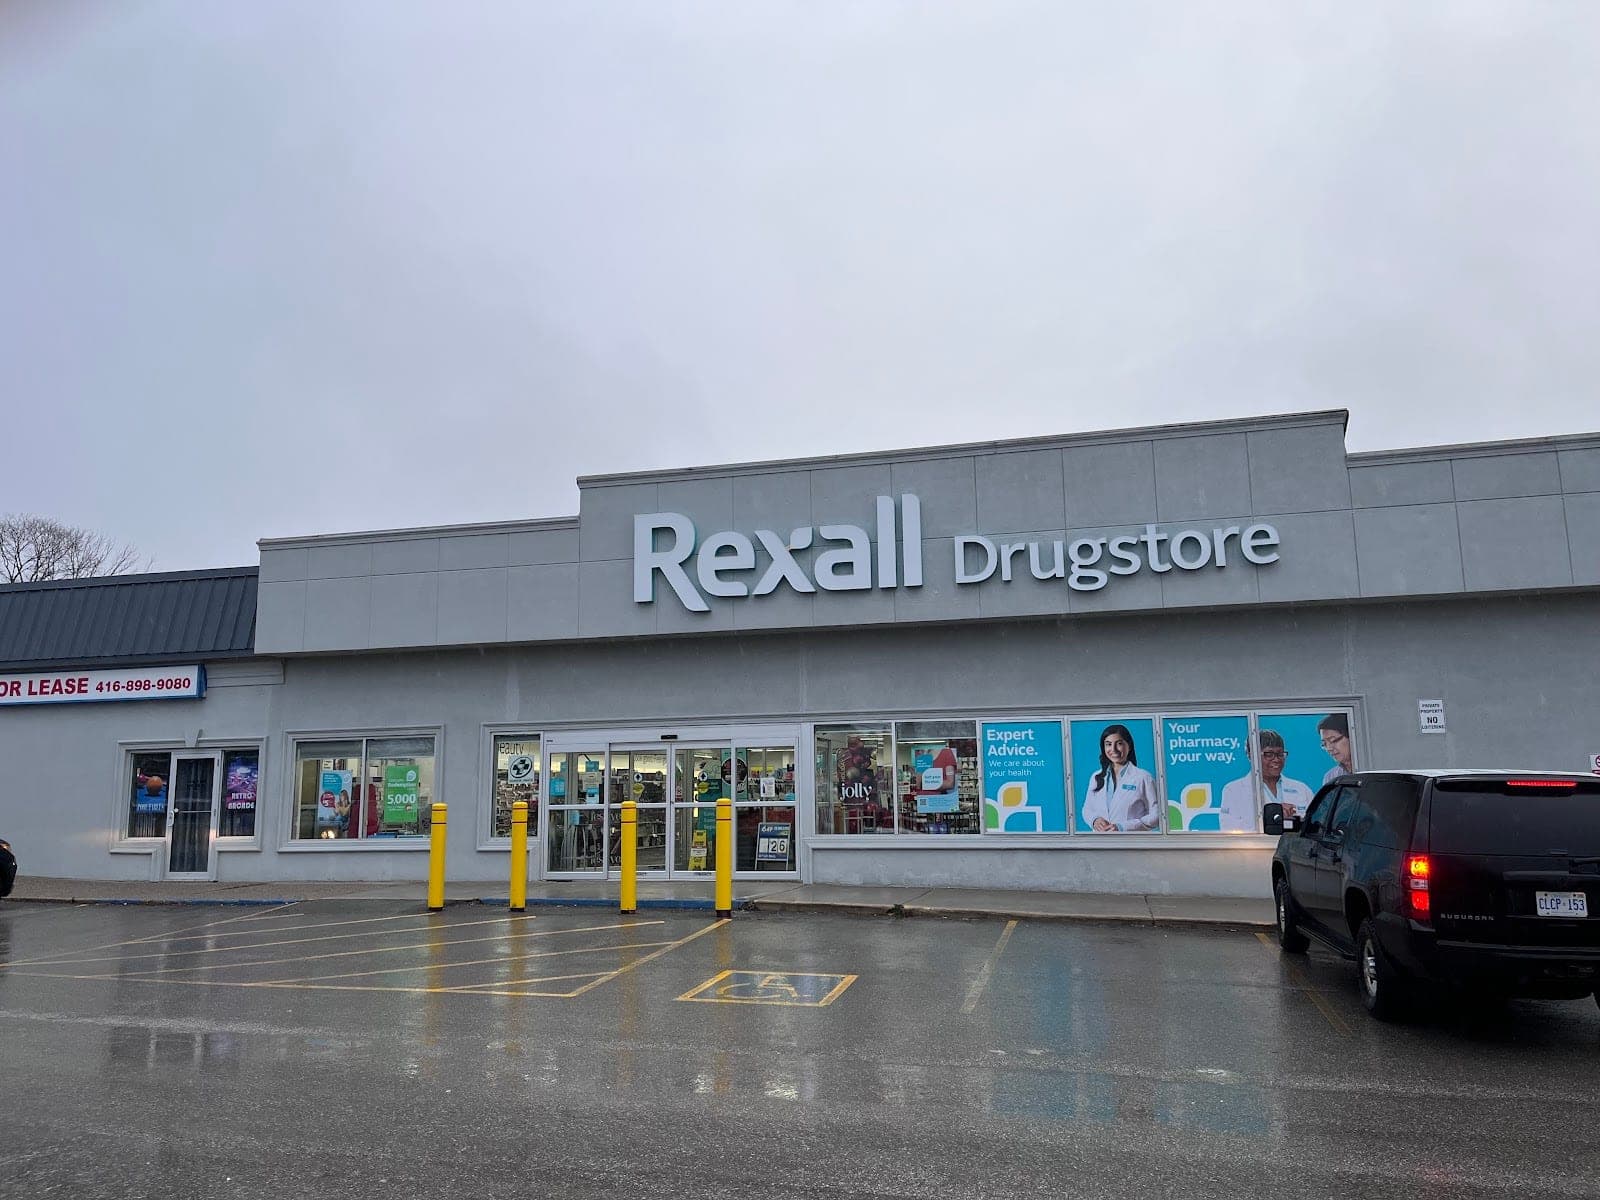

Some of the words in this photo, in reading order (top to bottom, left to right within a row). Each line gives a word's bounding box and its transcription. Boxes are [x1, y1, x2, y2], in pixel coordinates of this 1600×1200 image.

[633, 493, 923, 612] Rexall
[953, 522, 1281, 592] Drugstore
[0, 680, 22, 698] OR
[28, 677, 89, 696] LEASE
[95, 677, 191, 693] 416-898-9080
[1427, 716, 1438, 724] NO
[1168, 722, 1200, 734] Your
[986, 729, 1034, 744] Expert
[1170, 735, 1240, 750] pharmacy,
[988, 743, 1038, 757] Advice.
[989, 759, 1001, 768] We
[1003, 759, 1021, 768] care
[1022, 757, 1045, 767] about
[1170, 753, 1201, 766] your
[1206, 752, 1236, 764] way.
[989, 770, 1006, 778] your
[1008, 767, 1032, 777] health
[840, 782, 872, 801] jolly
[387, 793, 416, 805] 5,000
[1538, 898, 1561, 910] CLCP
[1568, 898, 1584, 911] 153
